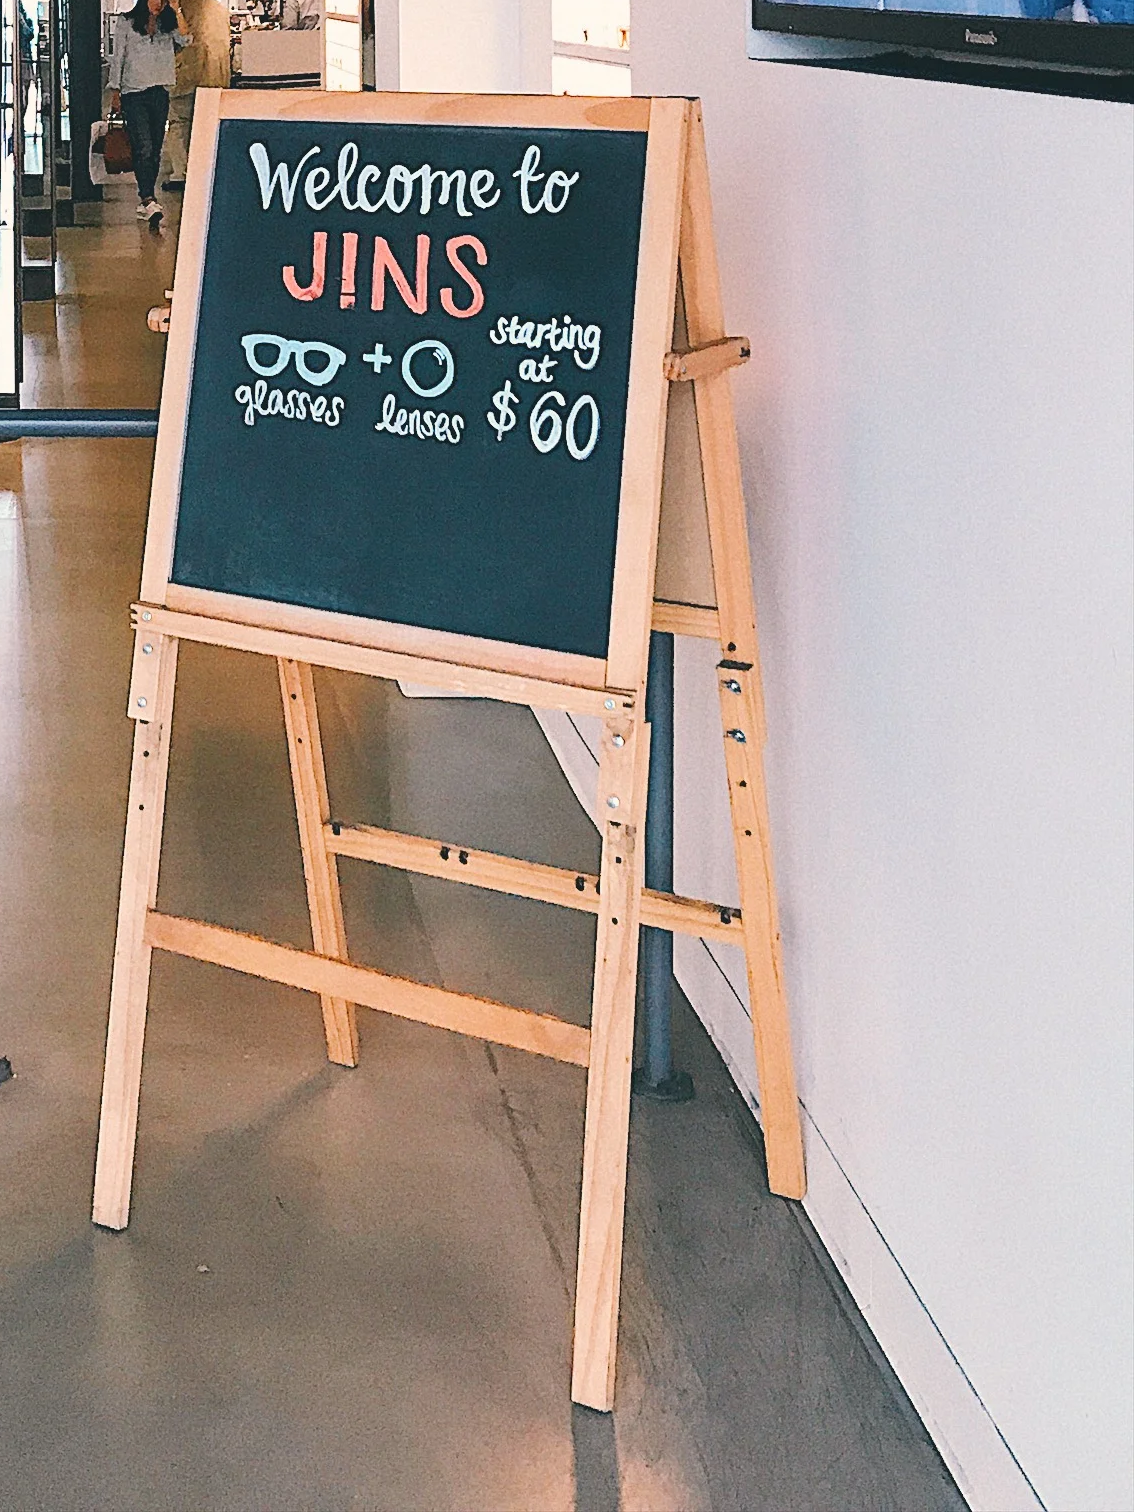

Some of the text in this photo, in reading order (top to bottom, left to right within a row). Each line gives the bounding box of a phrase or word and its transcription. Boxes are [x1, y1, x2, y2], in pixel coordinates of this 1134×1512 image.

[249, 142, 580, 217] Welcome to
[489, 315, 601, 371] starting
[518, 354, 559, 383] at
[235, 380, 465, 445] glasses lenses
